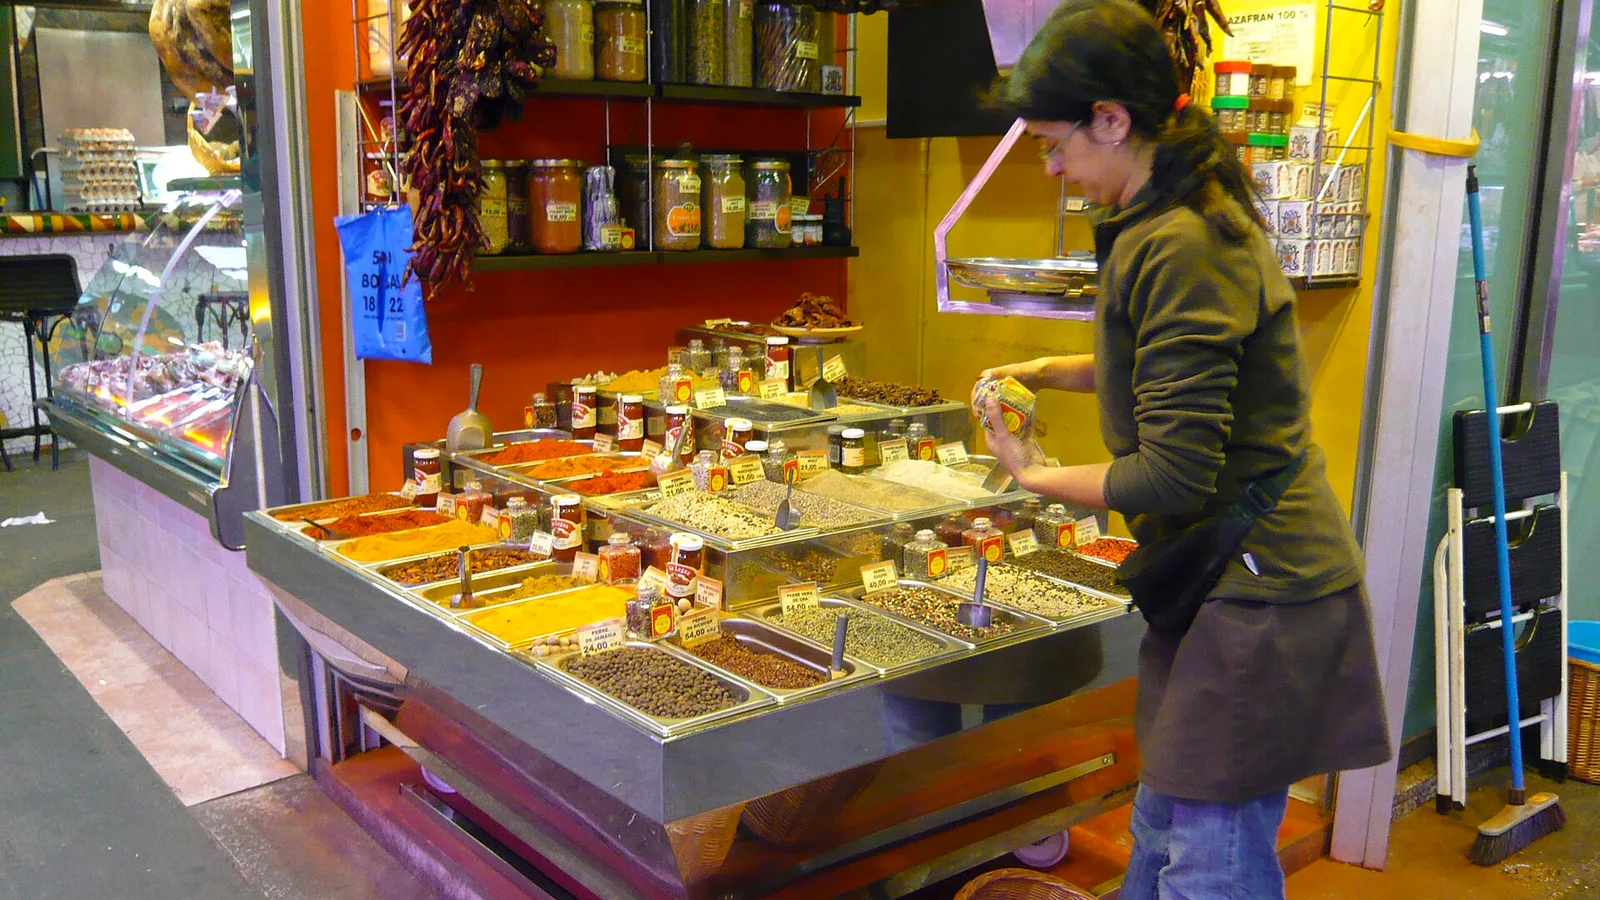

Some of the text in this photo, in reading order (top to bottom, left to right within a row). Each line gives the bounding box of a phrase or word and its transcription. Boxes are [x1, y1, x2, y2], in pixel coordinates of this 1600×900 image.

[1228, 12, 1274, 24] AZAFRAN
[1278, 10, 1296, 20] 100
[390, 298, 404, 313] 22
[594, 632, 616, 641] JAMAICA
[685, 628, 705, 640] 54,00
[583, 642, 608, 654] 24,00
